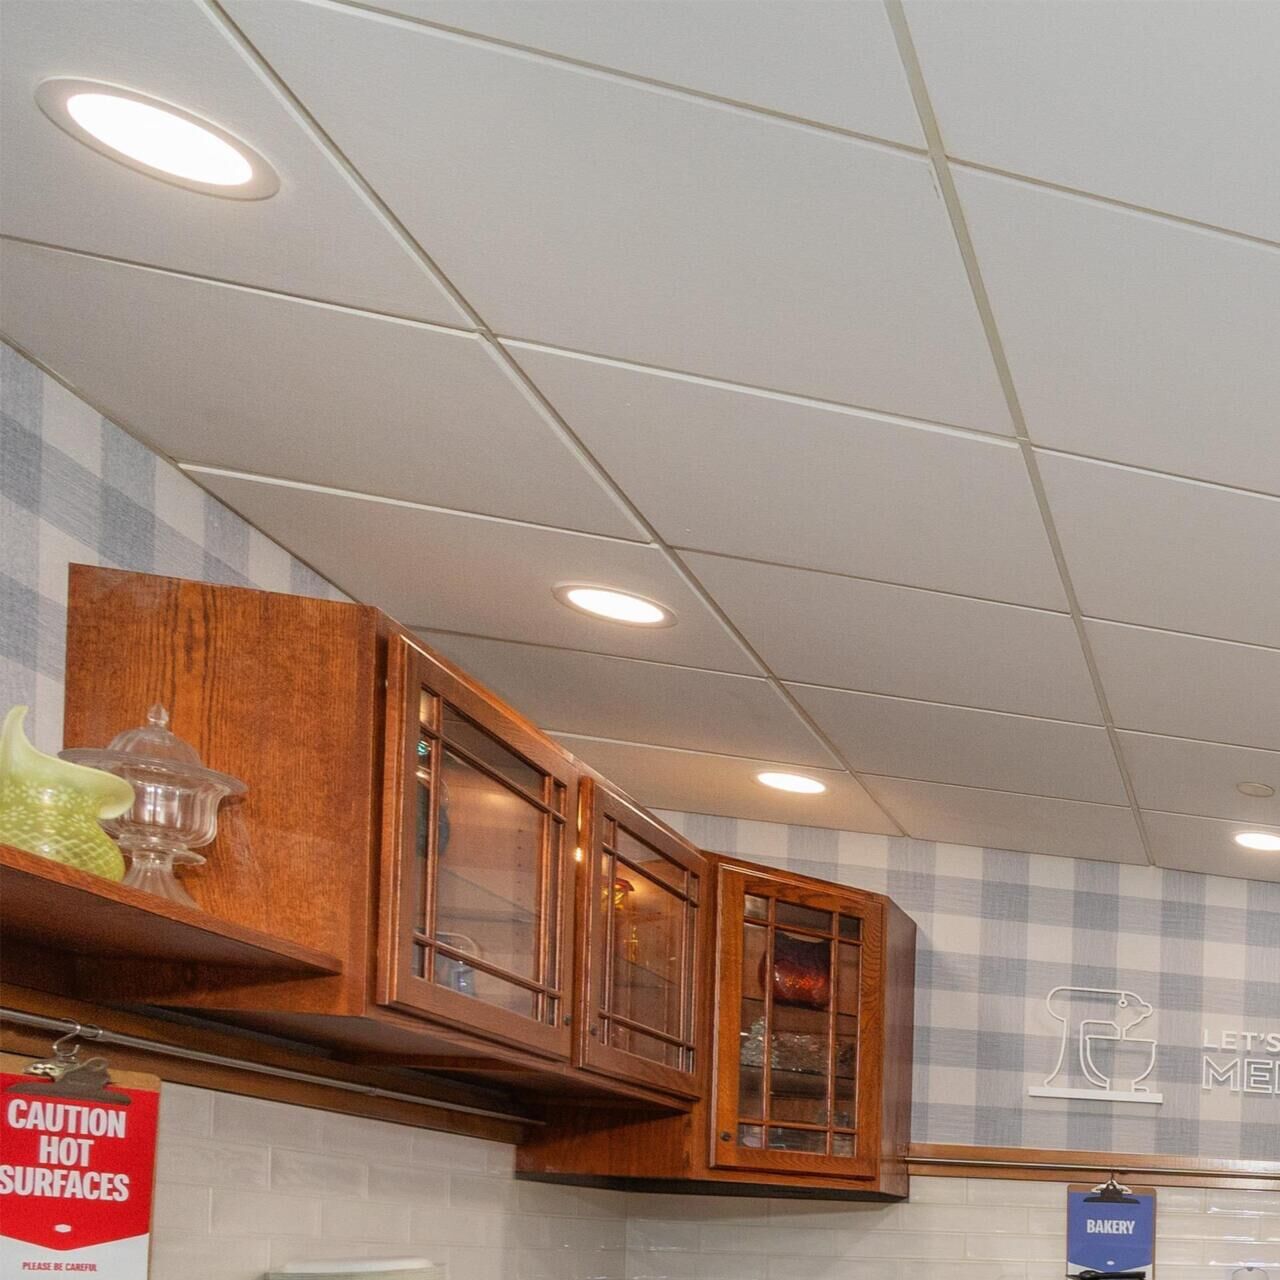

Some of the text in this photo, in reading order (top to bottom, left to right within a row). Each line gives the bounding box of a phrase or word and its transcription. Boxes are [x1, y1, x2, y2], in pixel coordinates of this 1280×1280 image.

[8, 1098, 126, 1138] CAUTION
[38, 1135, 95, 1167] HOT
[0, 1165, 130, 1202] SURFACES
[1086, 1219, 1136, 1235] BAKERY
[22, 1261, 98, 1273] PLEASE BE CAREFUL
